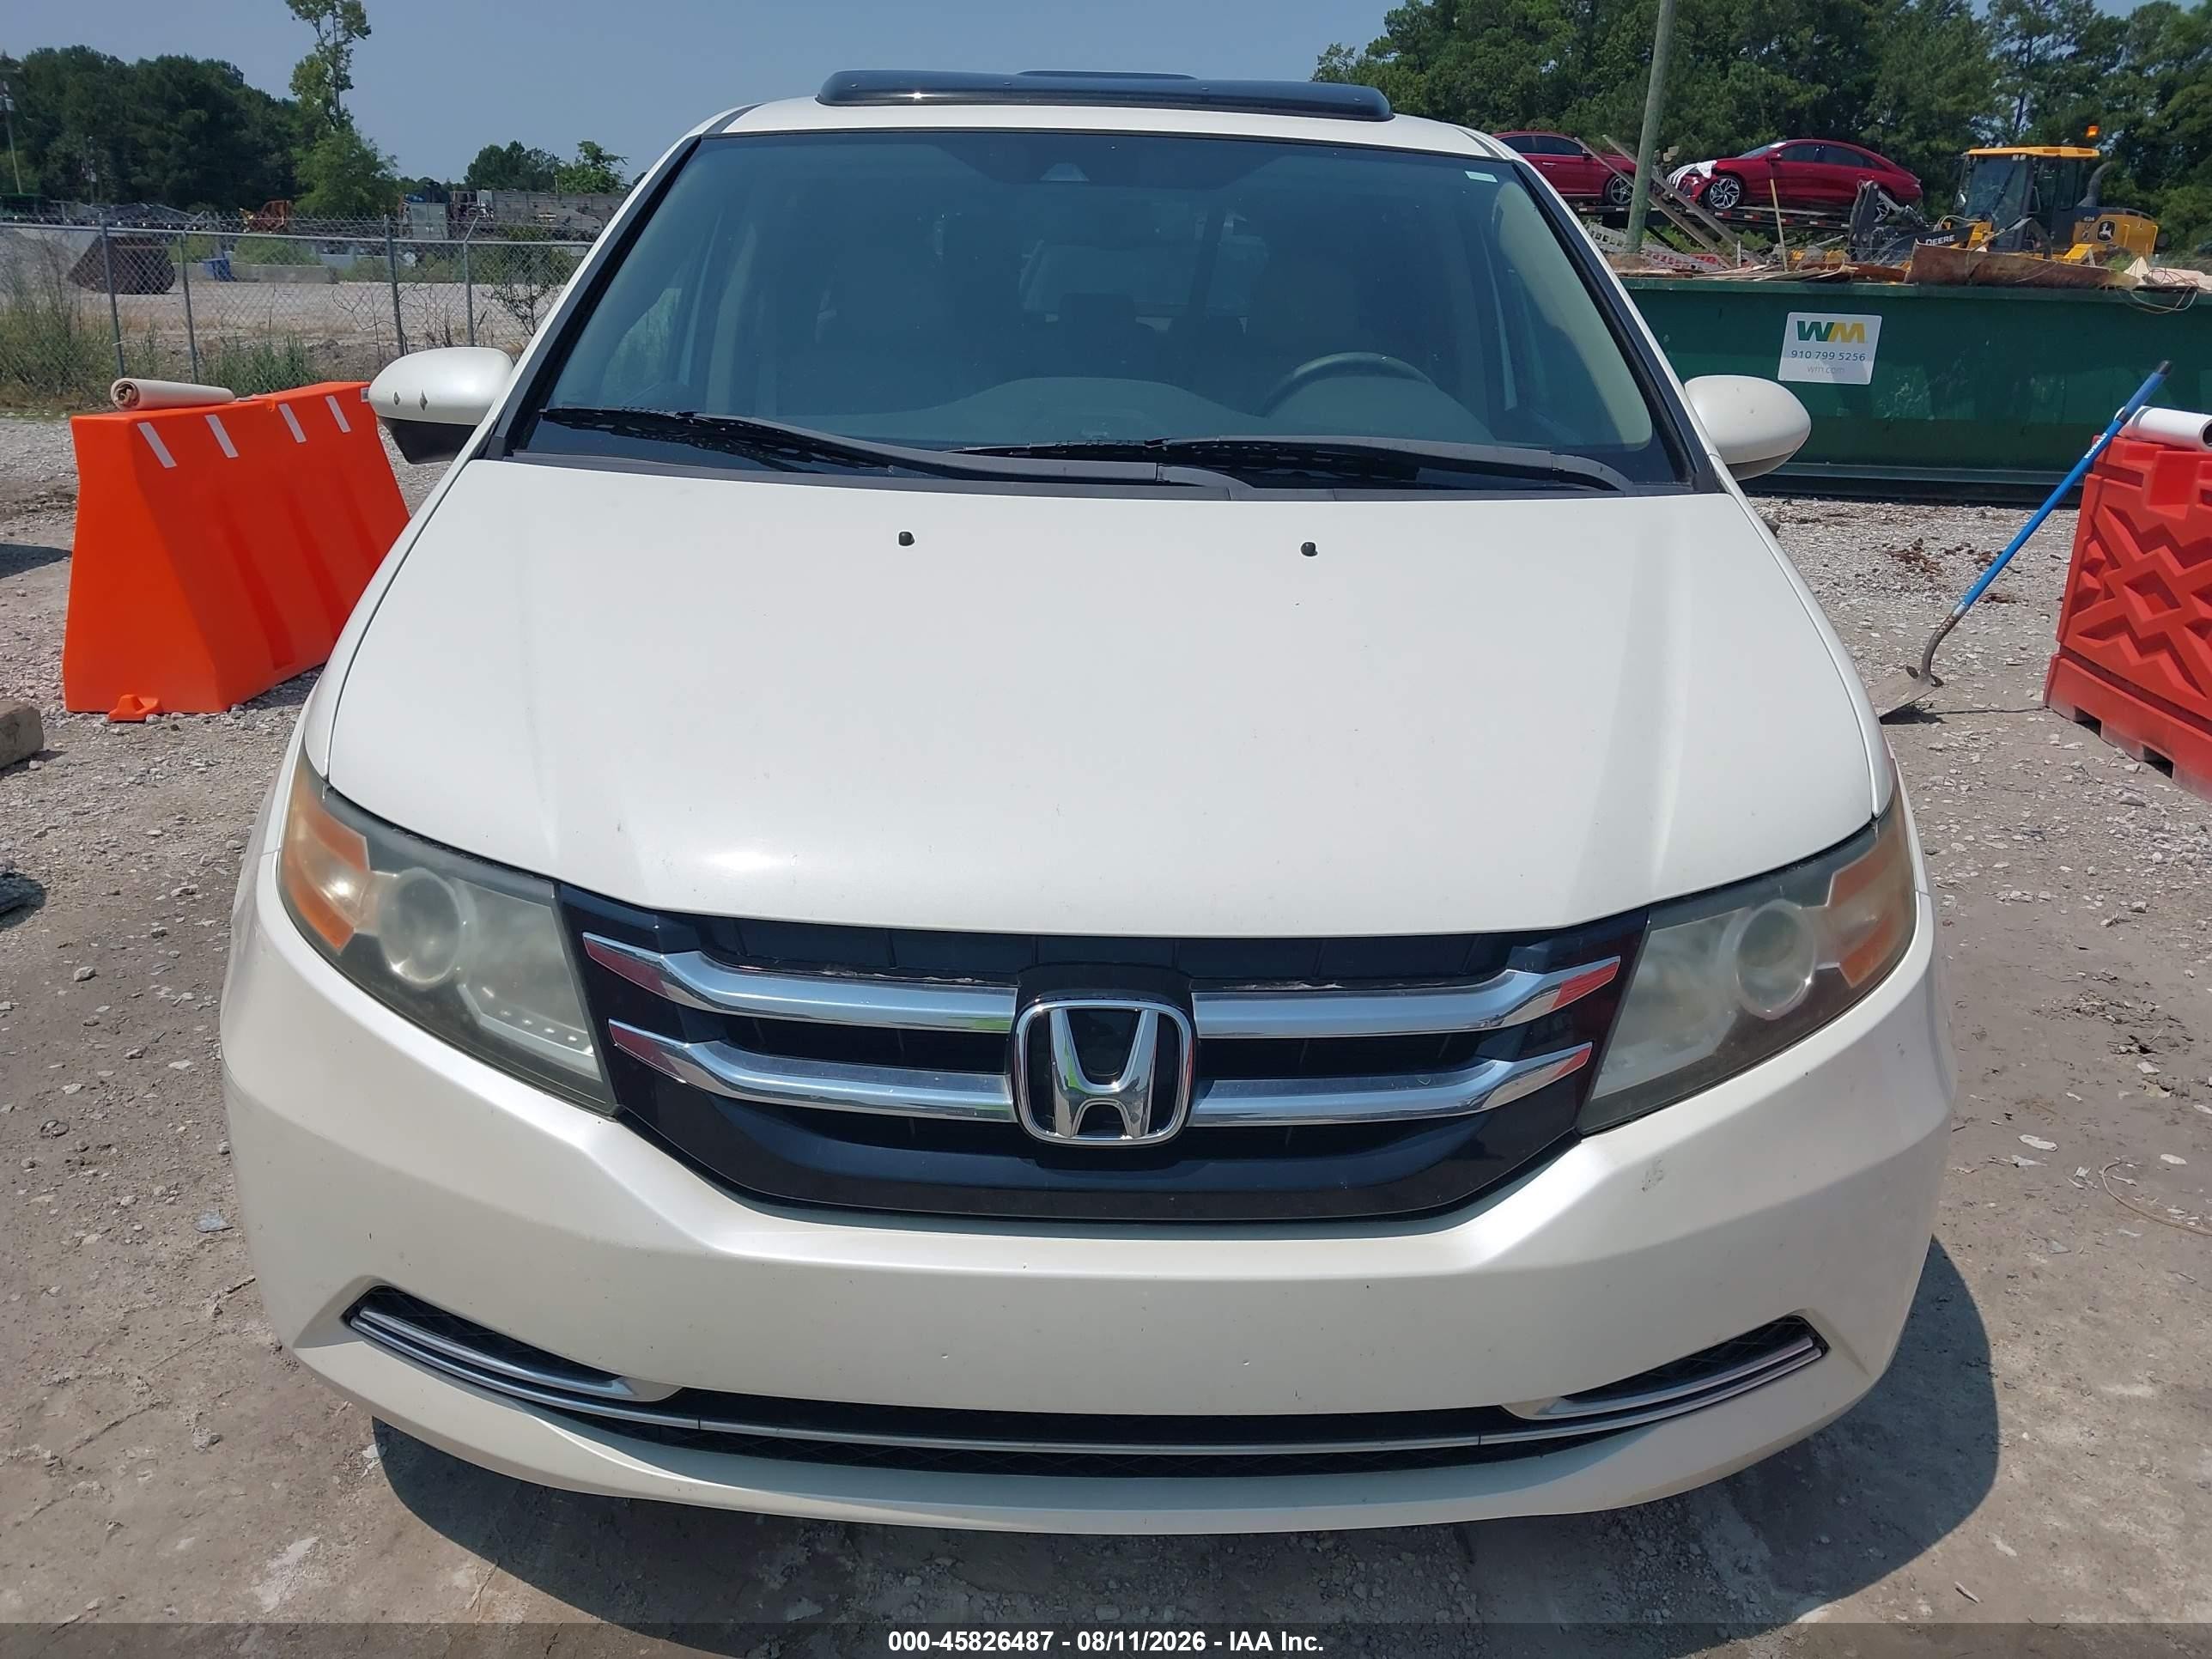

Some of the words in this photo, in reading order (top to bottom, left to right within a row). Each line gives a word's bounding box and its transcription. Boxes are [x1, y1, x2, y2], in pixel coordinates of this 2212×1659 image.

[1925, 234, 1955, 246] DEERE
[1796, 320, 1865, 343] WM
[1791, 349, 1812, 359] 910
[1815, 351, 1835, 361] 799
[1838, 352, 1866, 362] 5256
